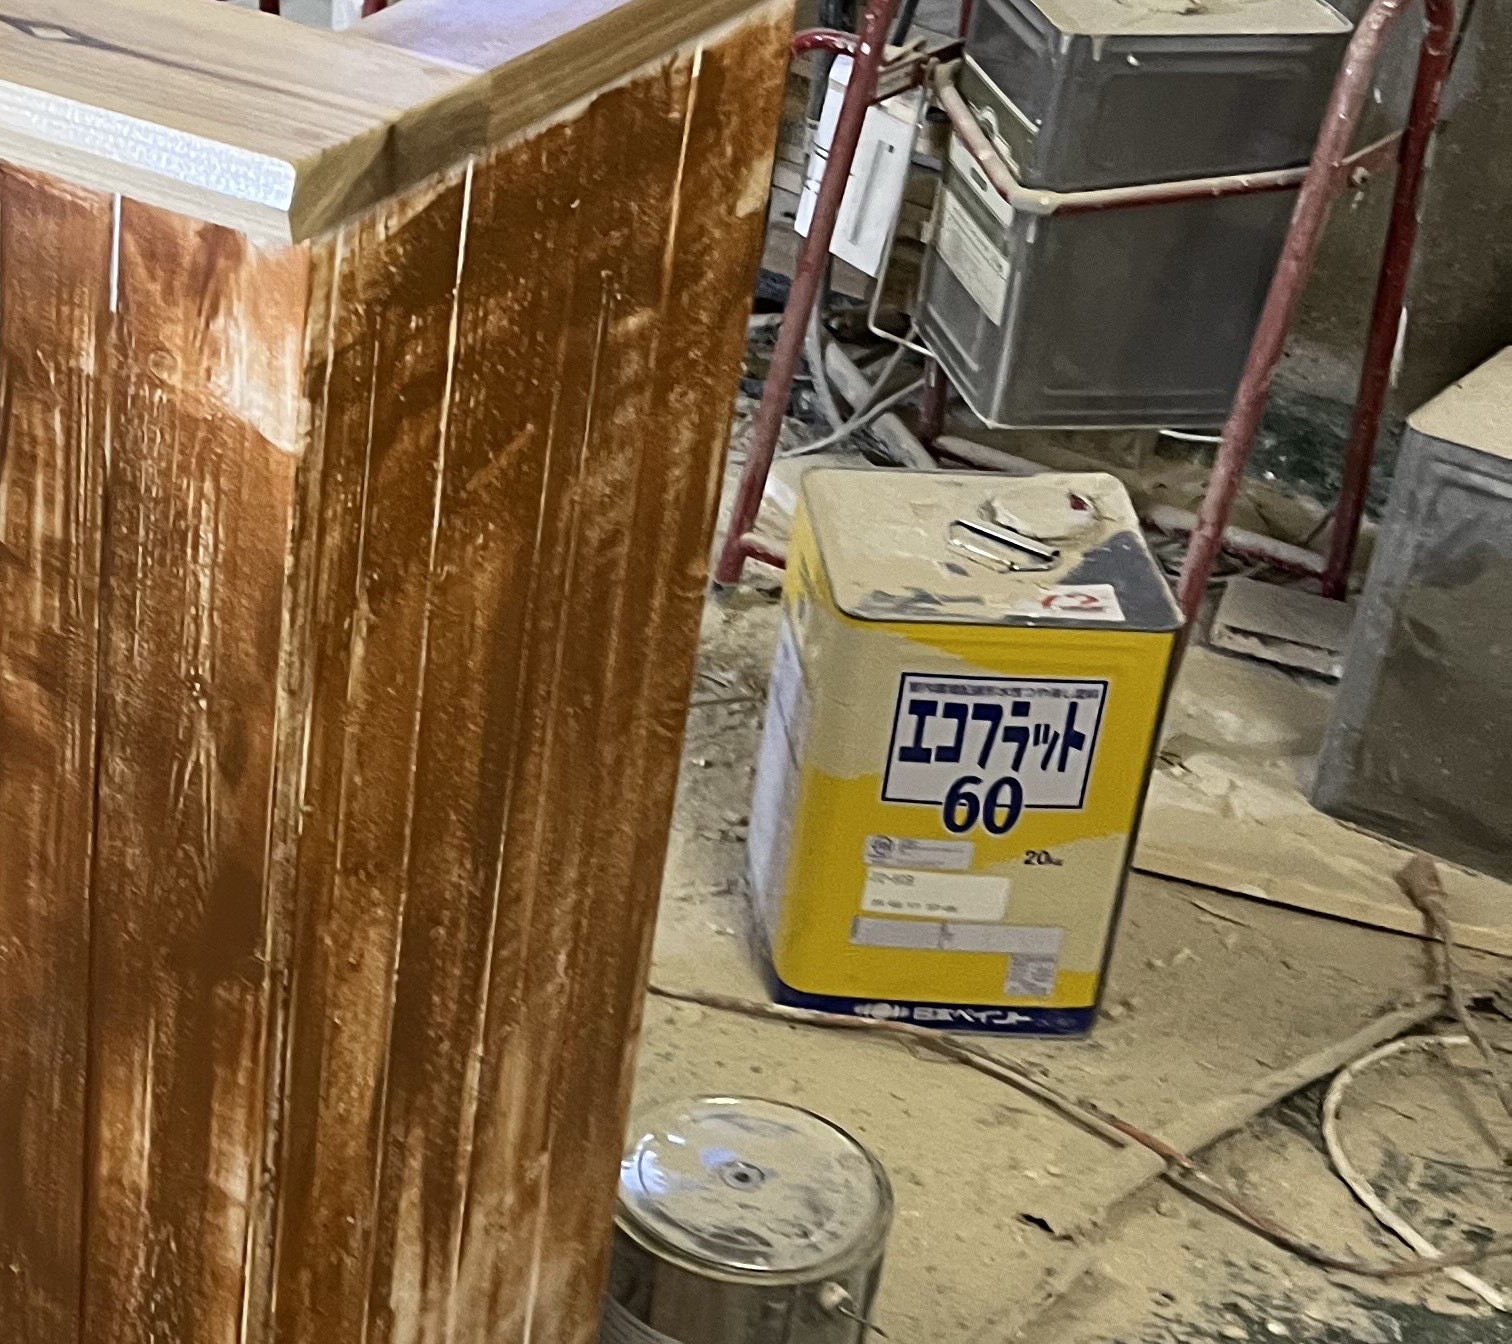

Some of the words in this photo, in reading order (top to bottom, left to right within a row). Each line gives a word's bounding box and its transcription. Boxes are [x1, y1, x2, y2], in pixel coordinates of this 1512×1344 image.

[898, 699, 1087, 774] エコフラット
[942, 774, 1024, 835] 60
